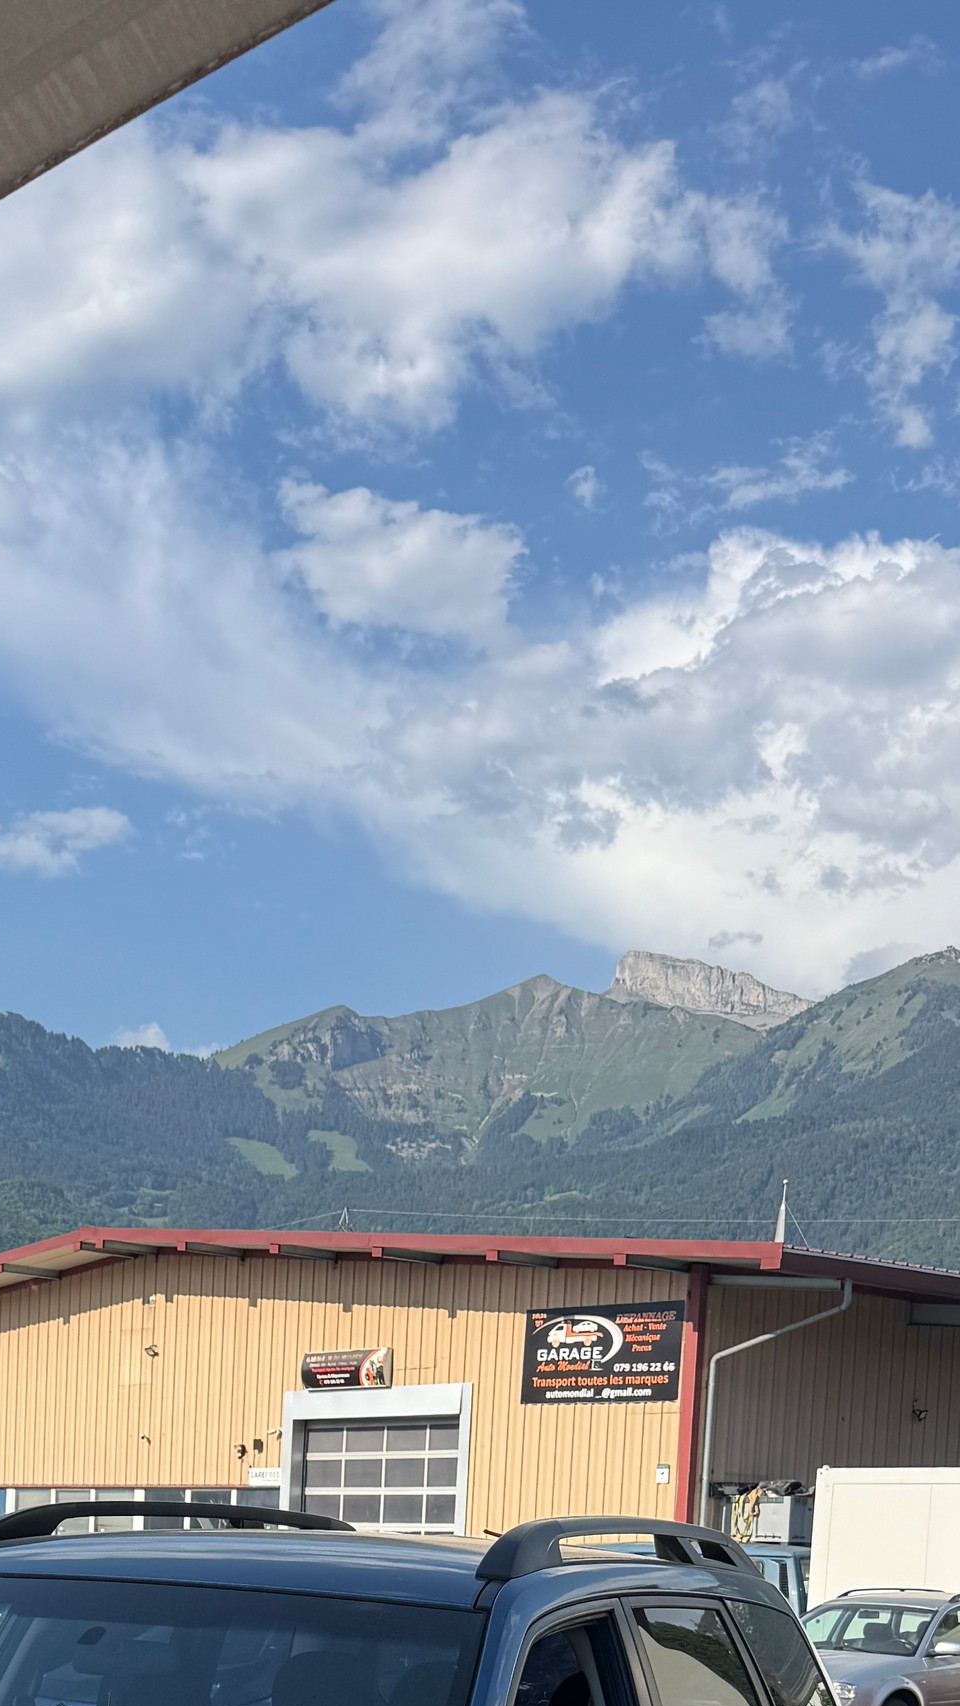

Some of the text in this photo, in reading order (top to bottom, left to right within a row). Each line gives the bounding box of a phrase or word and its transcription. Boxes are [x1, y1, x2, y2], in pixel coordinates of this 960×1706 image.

[537, 1346, 603, 1361] GARAGE
[536, 1359, 591, 1373] Auto Mondial
[613, 1361, 676, 1373] 079 196 22 66
[532, 1374, 669, 1389] Transport toutes les marques
